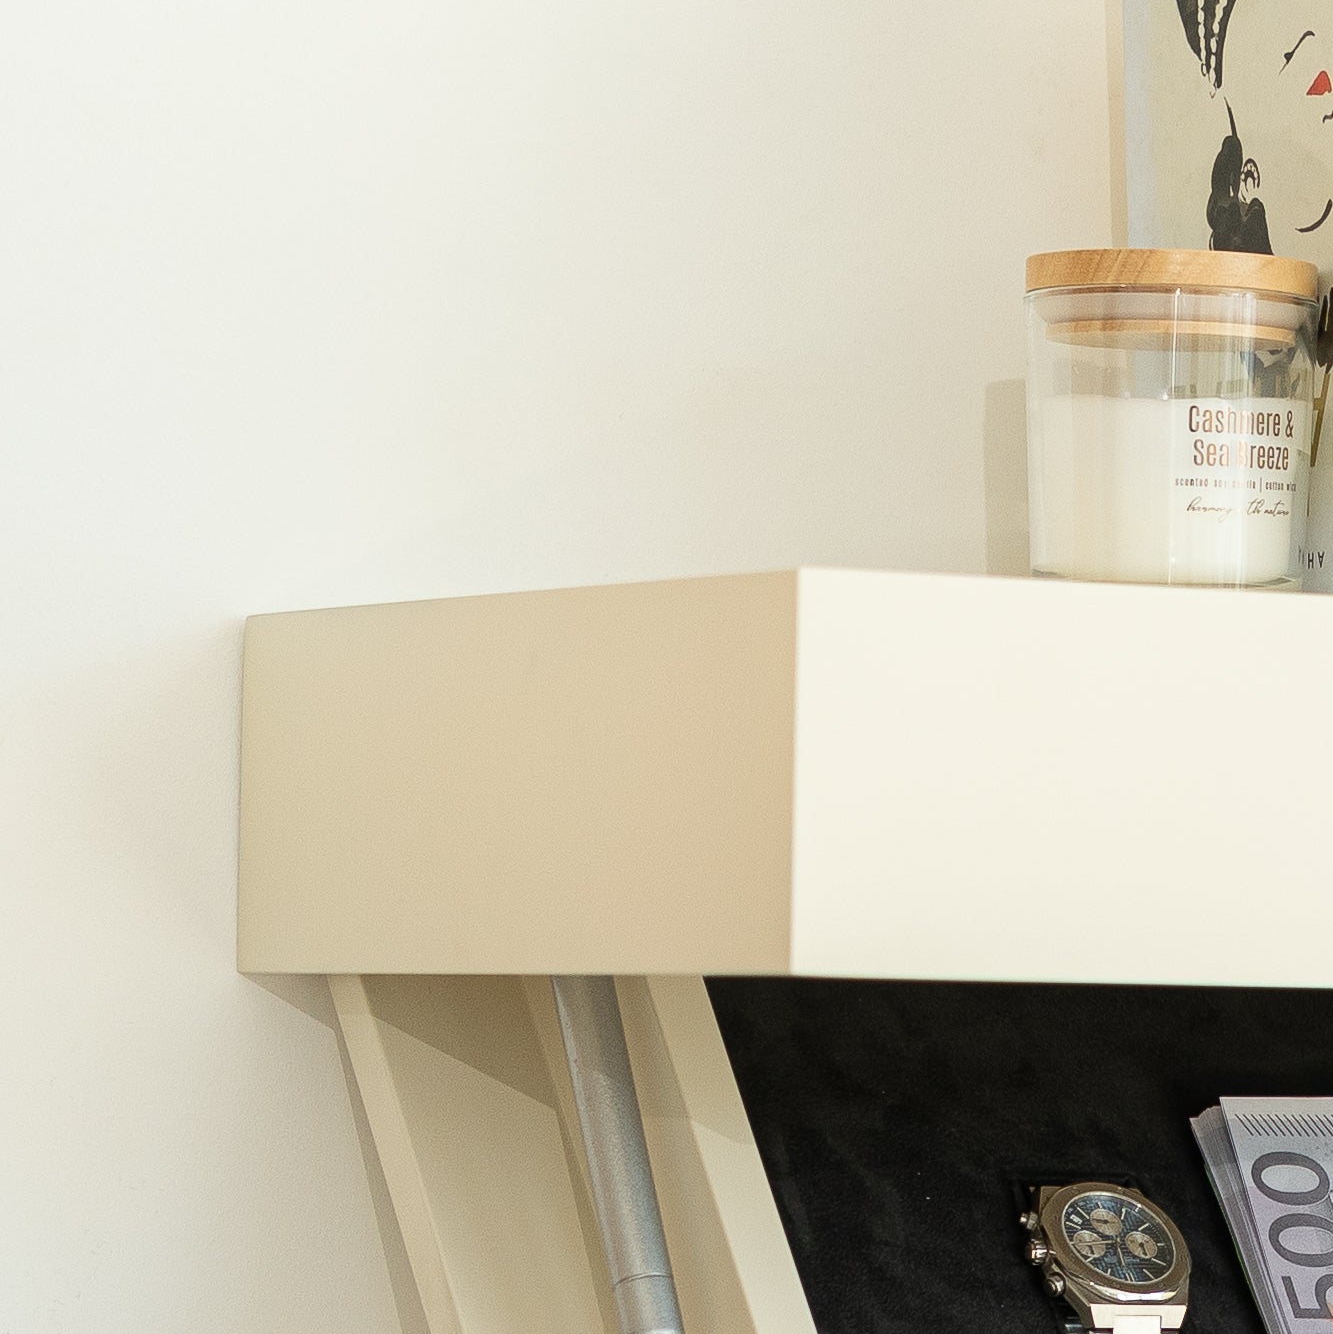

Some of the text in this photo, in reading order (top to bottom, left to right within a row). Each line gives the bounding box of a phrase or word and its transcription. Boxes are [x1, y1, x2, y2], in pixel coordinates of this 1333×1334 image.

[1188, 405, 1294, 438] Cashmere &
[1193, 438, 1289, 471] Sea Breeze
